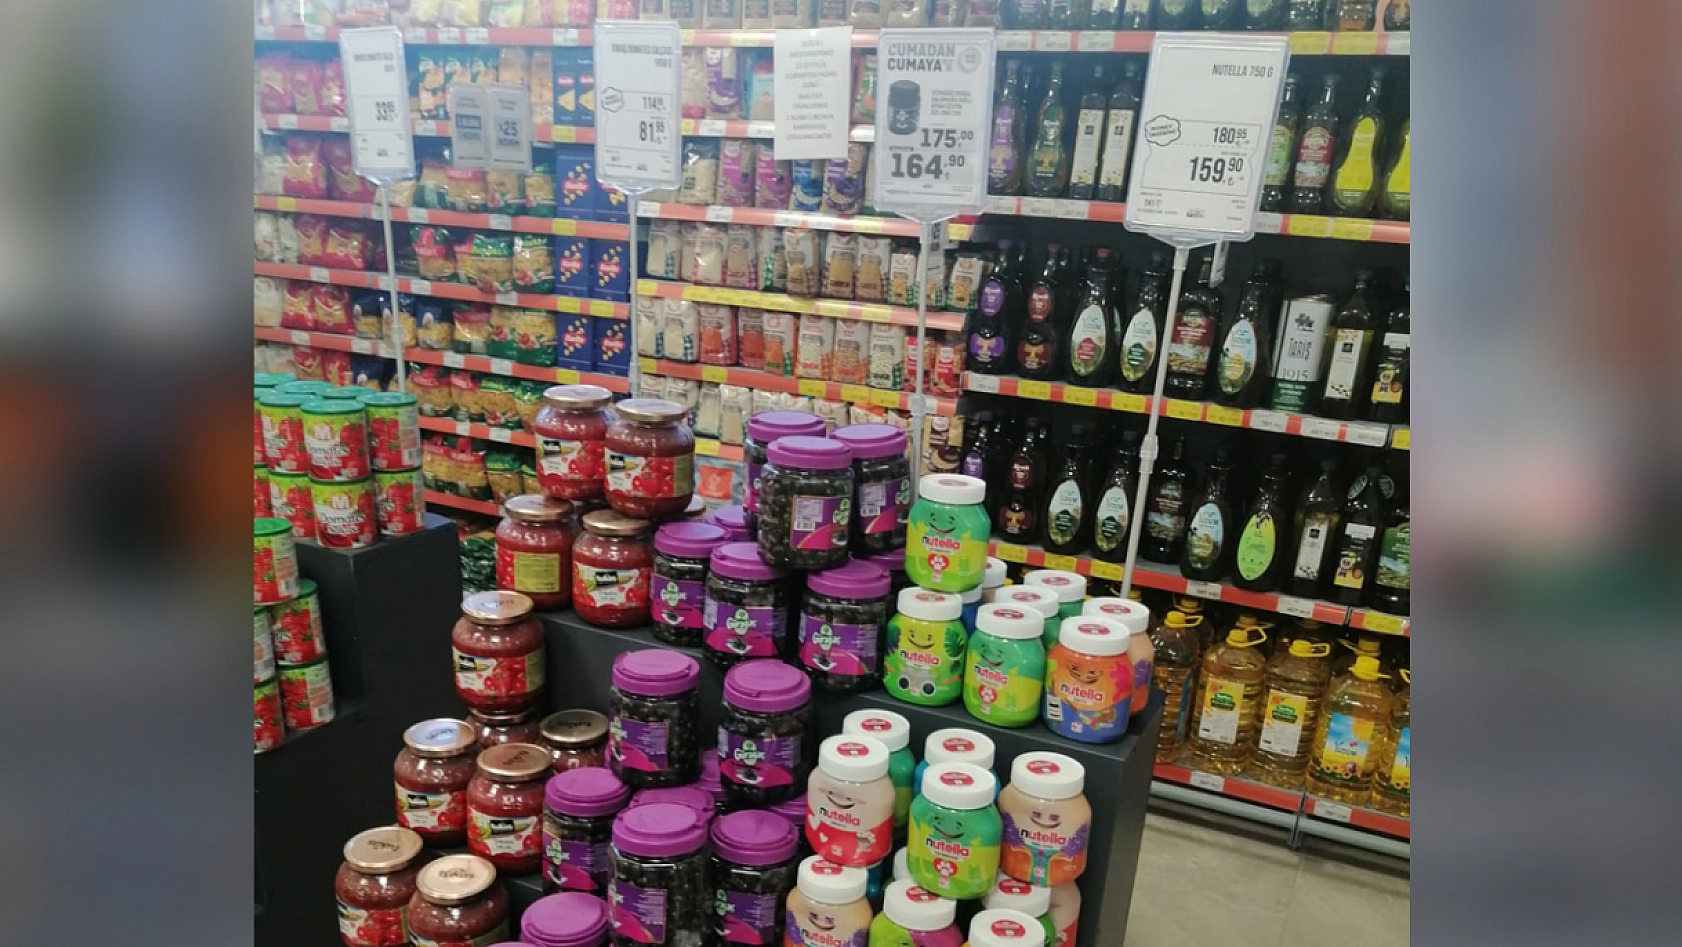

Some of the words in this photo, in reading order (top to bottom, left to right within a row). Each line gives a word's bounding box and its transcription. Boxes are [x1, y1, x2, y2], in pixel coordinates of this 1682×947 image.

[888, 43, 955, 58] CUMADAN
[887, 58, 943, 72] CUMAYA
[1212, 63, 1247, 76] NUTELLA
[1250, 65, 1265, 77] 750
[1267, 66, 1273, 77] G
[921, 535, 961, 551] nutella
[901, 649, 939, 665] nutella
[974, 664, 1008, 685] nutella
[1061, 683, 1103, 702] nutella
[819, 807, 860, 827] nutella
[1020, 828, 1066, 846] nutella
[926, 837, 969, 857] nutella
[801, 928, 842, 947] nutella
